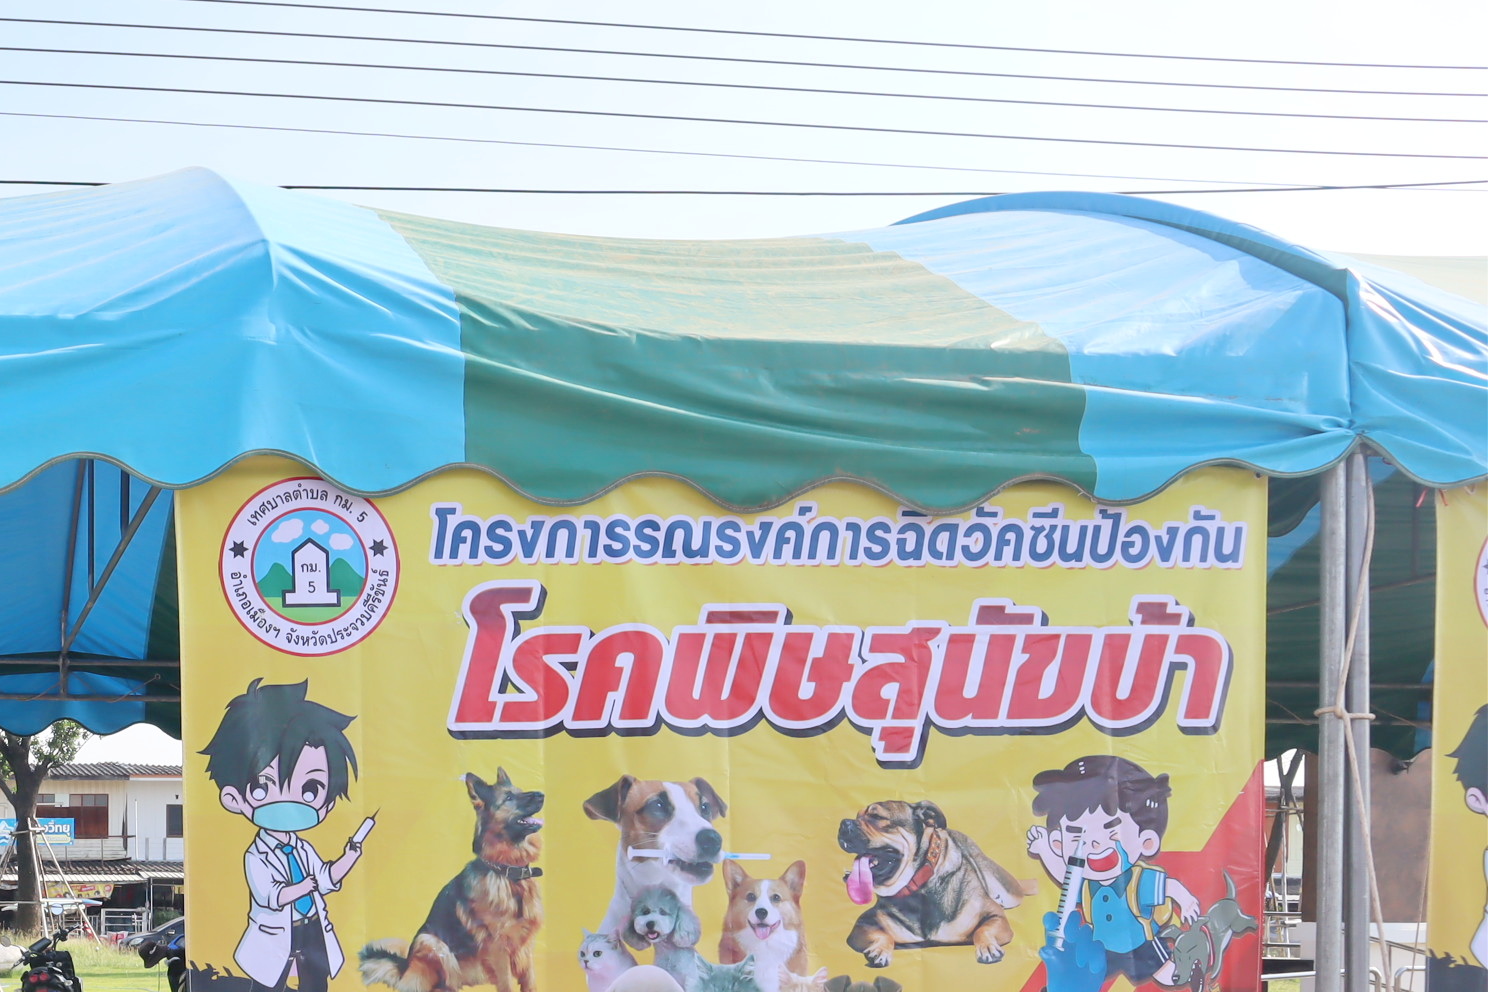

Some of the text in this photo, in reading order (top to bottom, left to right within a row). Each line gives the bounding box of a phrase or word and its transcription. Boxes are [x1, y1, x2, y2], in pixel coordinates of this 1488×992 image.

[246, 482, 369, 527] เทศบาลตำบล กม. 5
[300, 561, 322, 574] กม.
[307, 580, 317, 594] 5
[450, 583, 1229, 760] โรคพิษสุนัขบ้า
